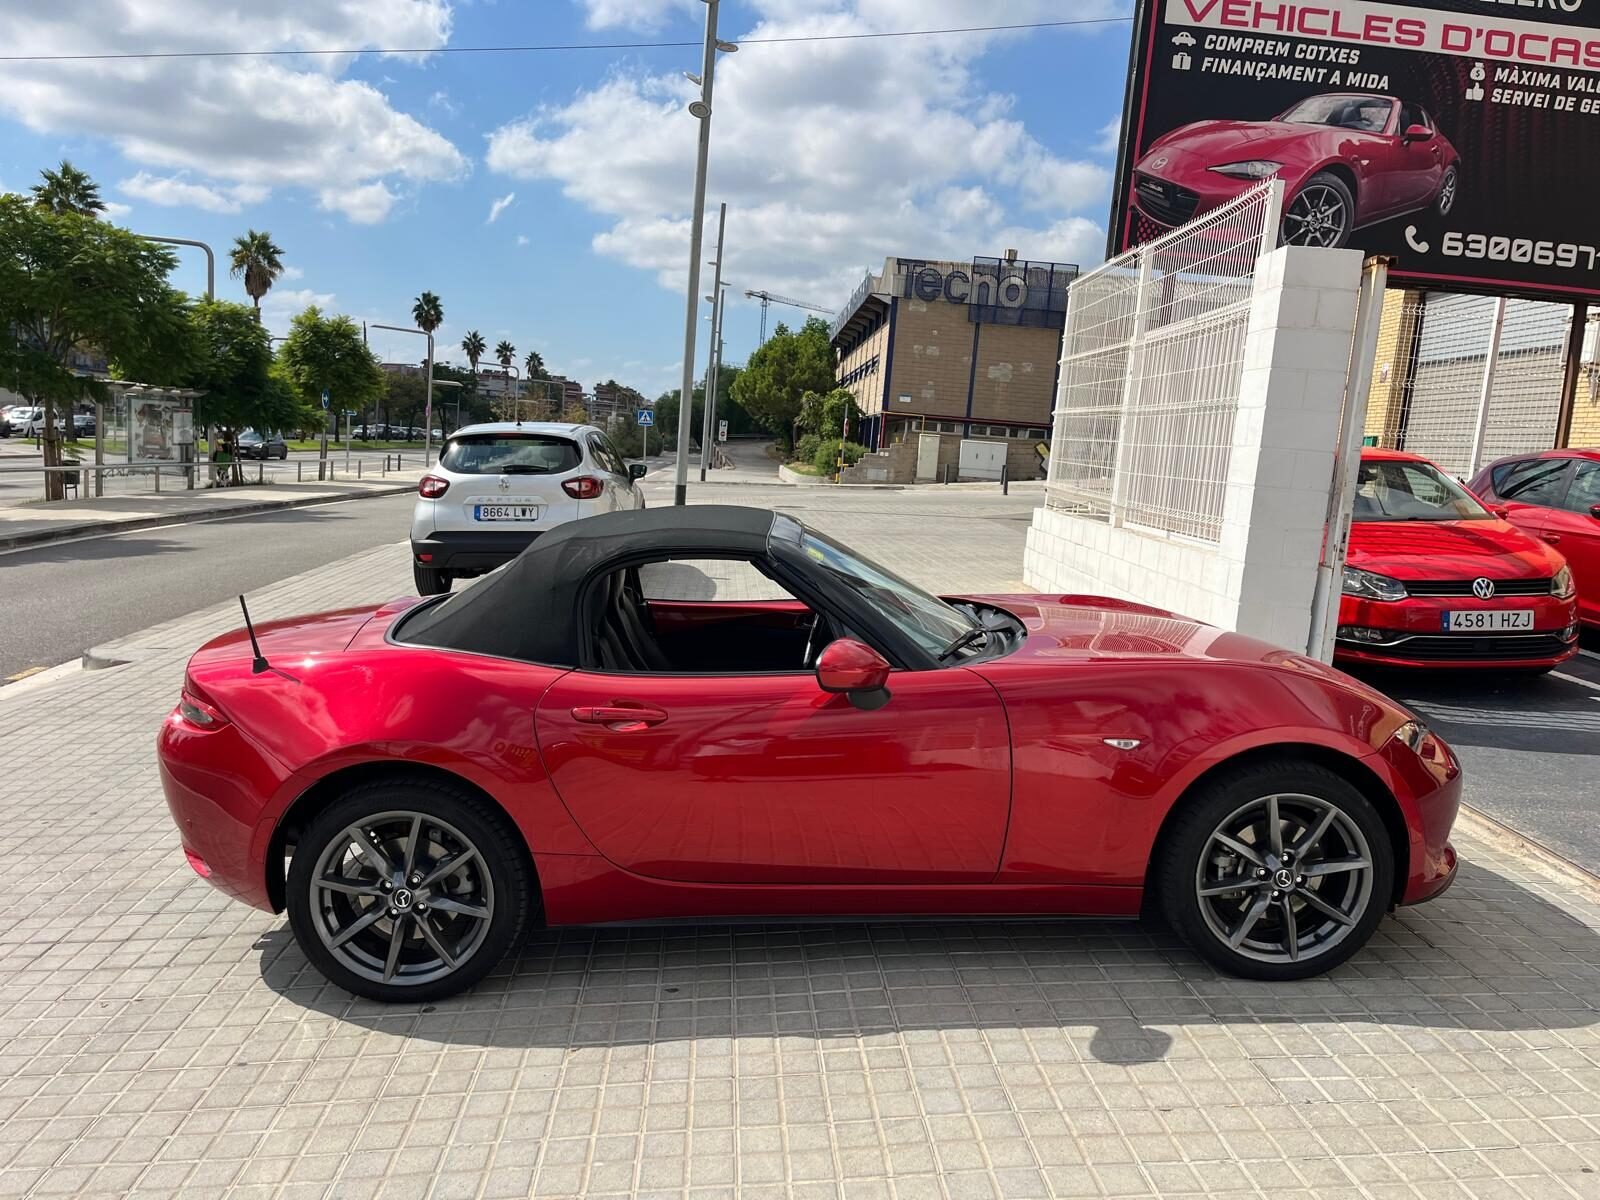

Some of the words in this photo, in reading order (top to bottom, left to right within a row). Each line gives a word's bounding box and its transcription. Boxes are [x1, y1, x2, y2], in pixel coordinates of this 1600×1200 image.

[1183, 0, 1427, 47] VEHICLES
[1204, 34, 1291, 57] COMPREM
[1294, 43, 1361, 65] COTXES
[1201, 57, 1328, 82] FINANÇAMENT
[1329, 71, 1342, 86] A
[1346, 72, 1389, 91] MIDA
[1494, 65, 1560, 89] MÀXIMA
[1491, 88, 1550, 109] SERVEI
[1554, 95, 1577, 111] DE
[1580, 98, 1600, 114] GE
[1441, 231, 1600, 270] 6300697
[897, 258, 1028, 309] Tecno
[483, 507, 509, 517] 8664
[1454, 613, 1493, 628] 4581
[1501, 613, 1531, 628] HZJ
